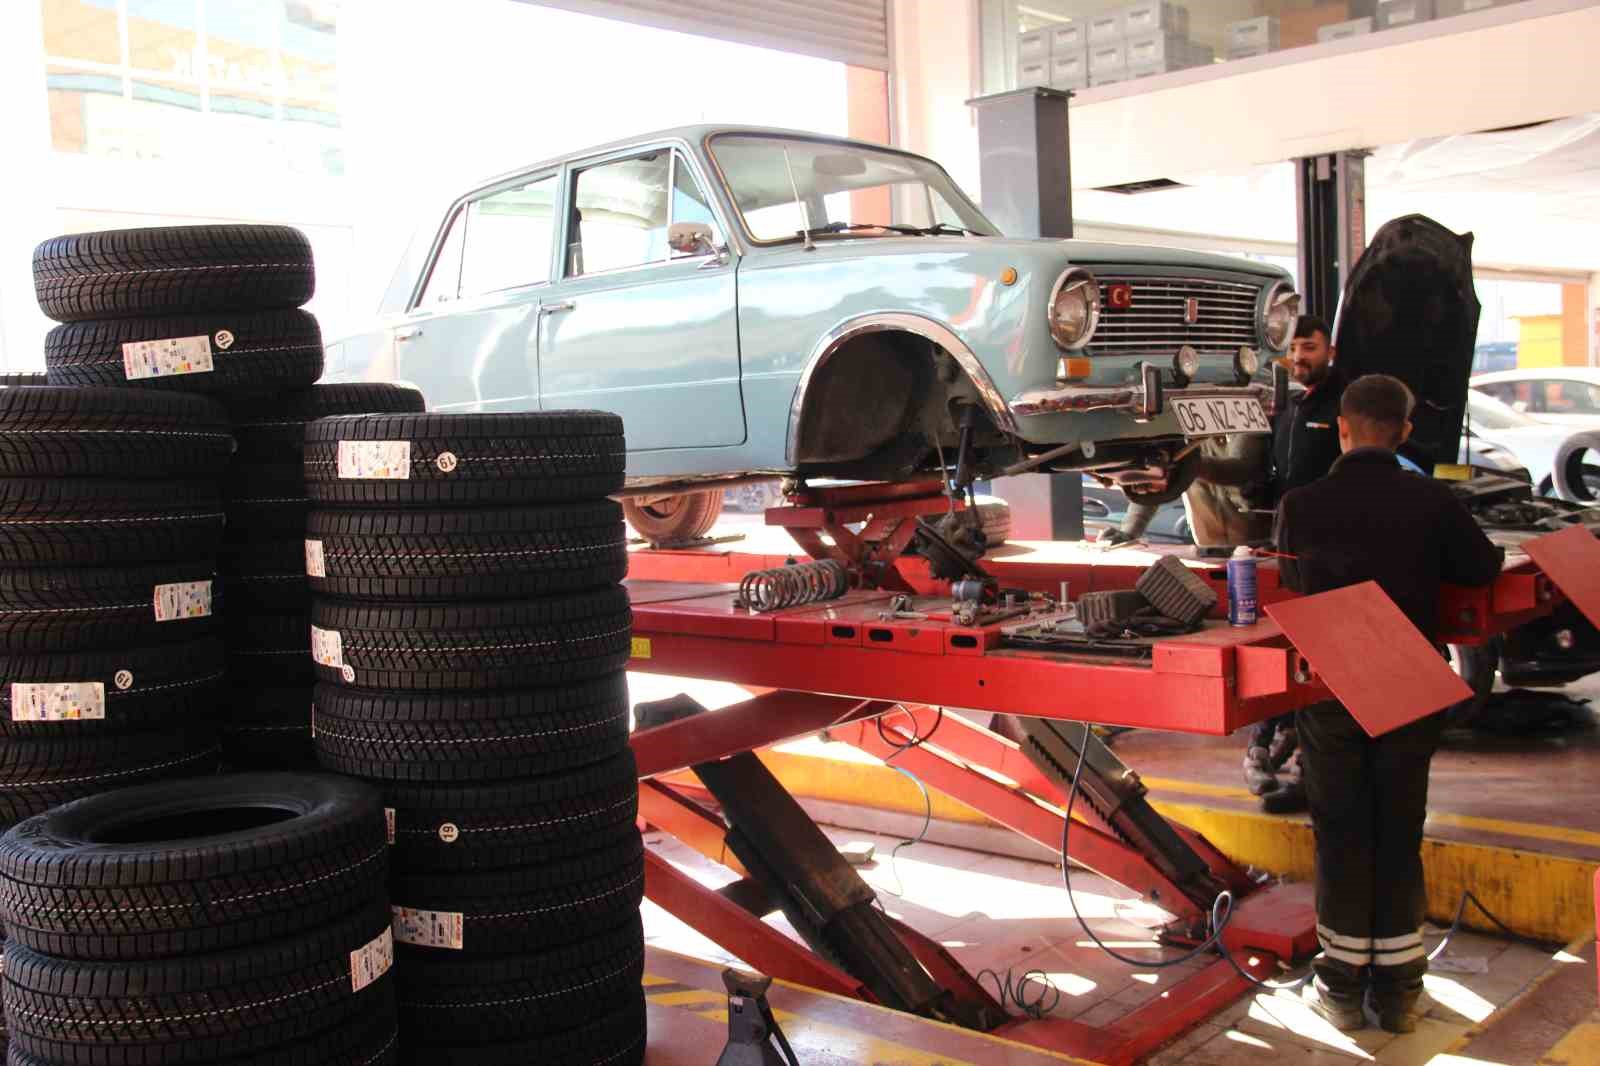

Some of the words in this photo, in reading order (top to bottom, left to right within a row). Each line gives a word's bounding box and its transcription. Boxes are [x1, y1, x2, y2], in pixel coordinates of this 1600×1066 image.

[1177, 402, 1206, 431] 06
[1206, 401, 1235, 430] NZ
[1234, 401, 1268, 428] 543
